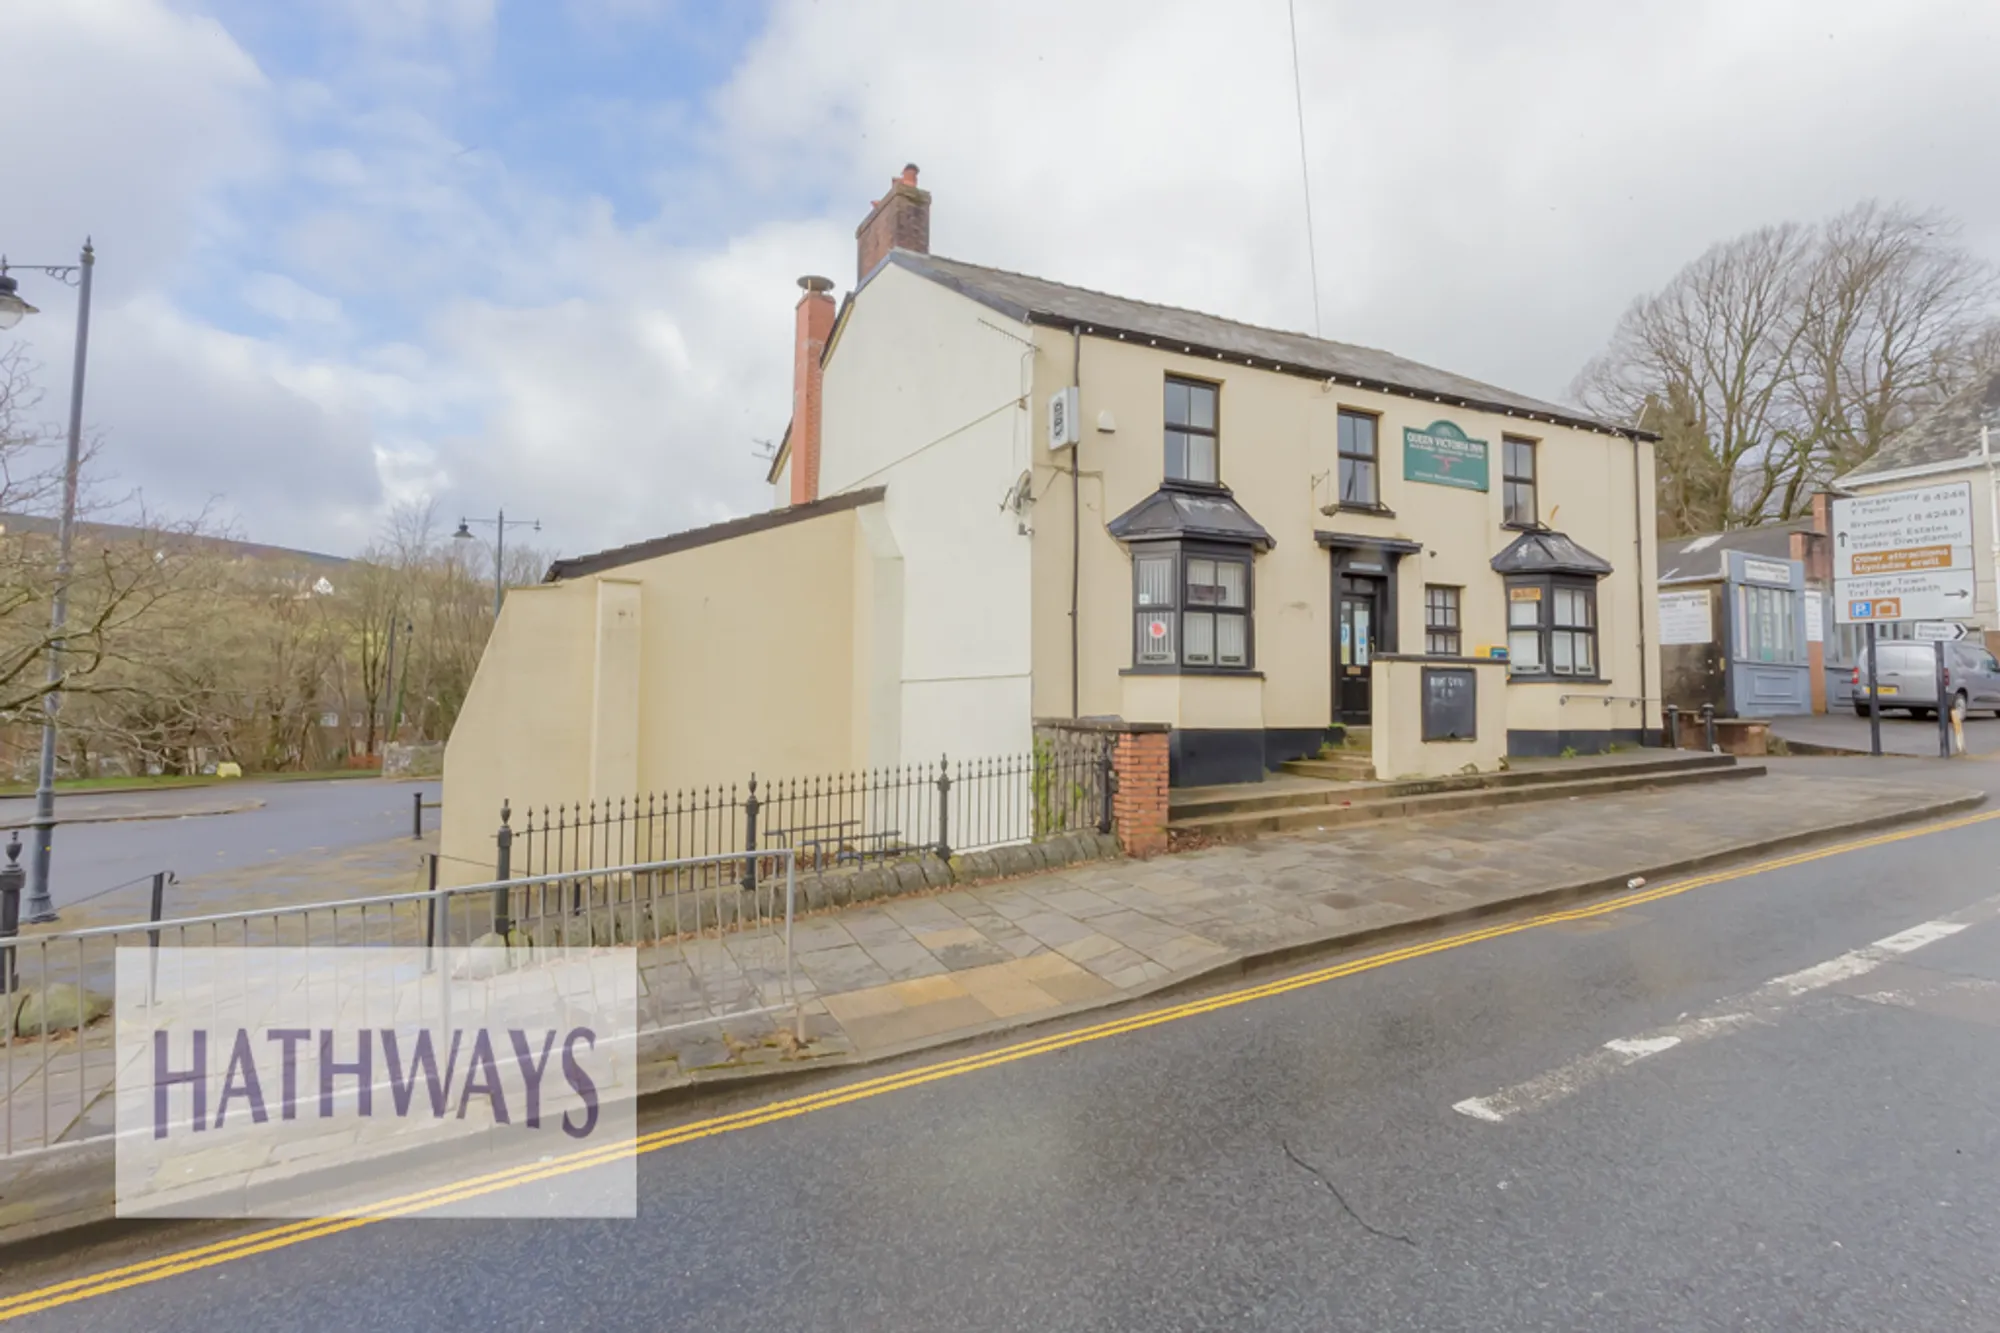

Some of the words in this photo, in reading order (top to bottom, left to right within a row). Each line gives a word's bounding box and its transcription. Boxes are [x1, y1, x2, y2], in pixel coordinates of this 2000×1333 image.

[1407, 432, 1433, 445] QUEEN
[1434, 437, 1468, 450] VICTORIA
[1850, 529, 1902, 542] Industrial
[1906, 525, 1949, 535] Estates
[1847, 579, 1893, 590] Heritage
[1897, 576, 1927, 586] Town
